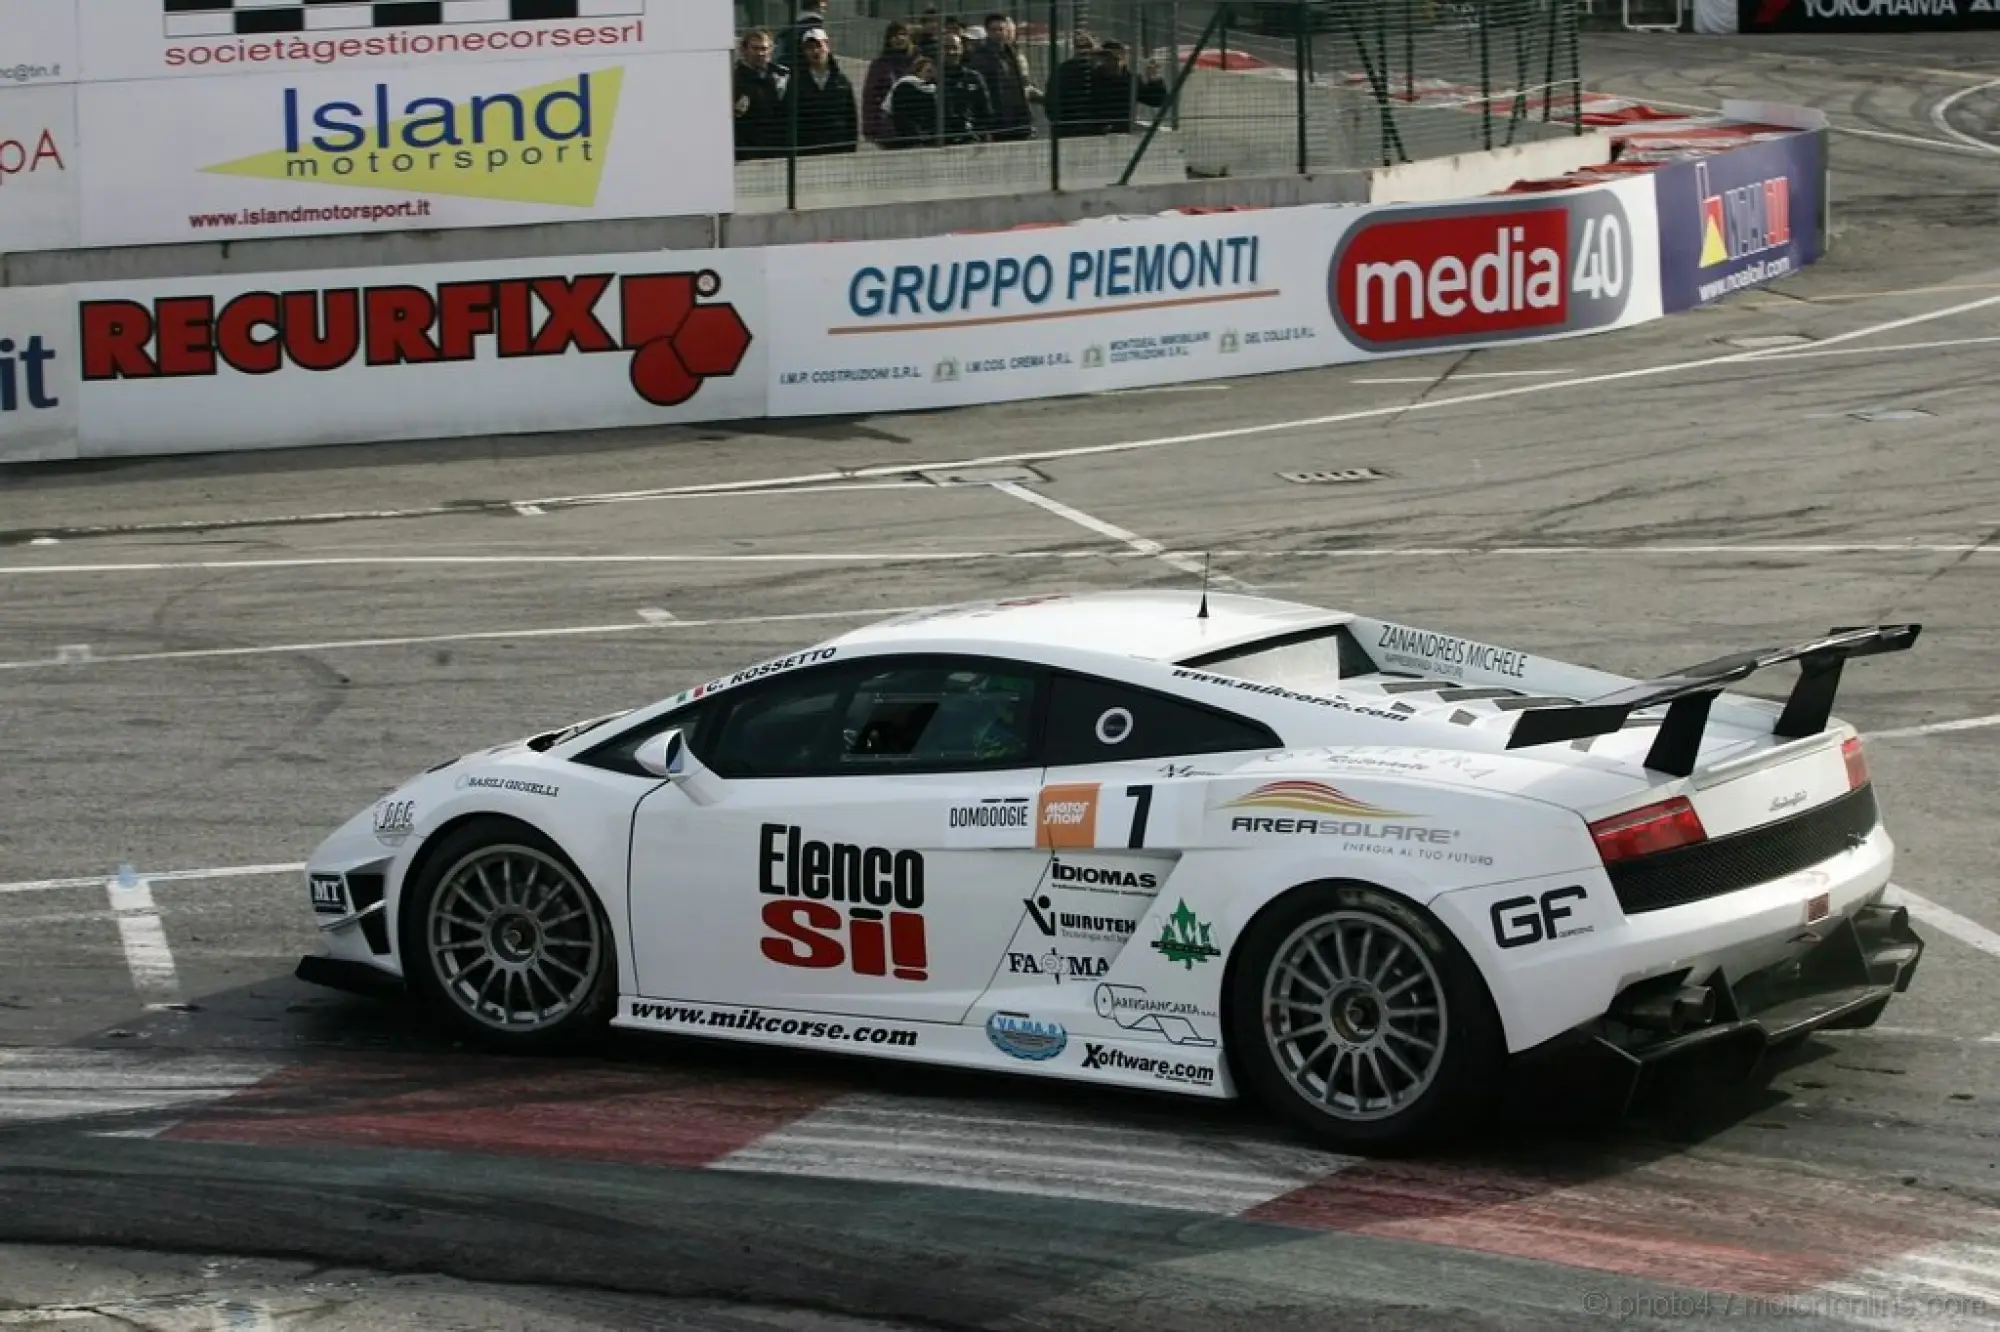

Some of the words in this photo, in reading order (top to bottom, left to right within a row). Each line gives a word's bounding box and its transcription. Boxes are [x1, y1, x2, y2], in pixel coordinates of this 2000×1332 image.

[164, 20, 645, 68] societàgestionecorsesrl
[284, 72, 593, 154] Island
[286, 140, 594, 178] motorsport
[189, 201, 430, 230] www.islandmotorsport.it
[848, 253, 1054, 318] GRUPPO
[1066, 235, 1259, 301] PIEMONTI
[1355, 226, 1560, 325] media
[1571, 214, 1624, 299] 40
[79, 273, 616, 381] RECURFIX
[730, 646, 837, 685] ROSSETTO
[1466, 643, 1528, 679] MICHELE
[1172, 668, 1409, 722] www.mikcorse.com
[1125, 784, 1154, 850] 7
[759, 821, 925, 909] Elenco
[1418, 848, 1443, 861] TUO
[1447, 851, 1494, 867] FUTURO
[1489, 884, 1589, 950] GF
[630, 1001, 918, 1047] www.mikcorse.com
[1081, 1043, 1214, 1081] Xoftware.com
